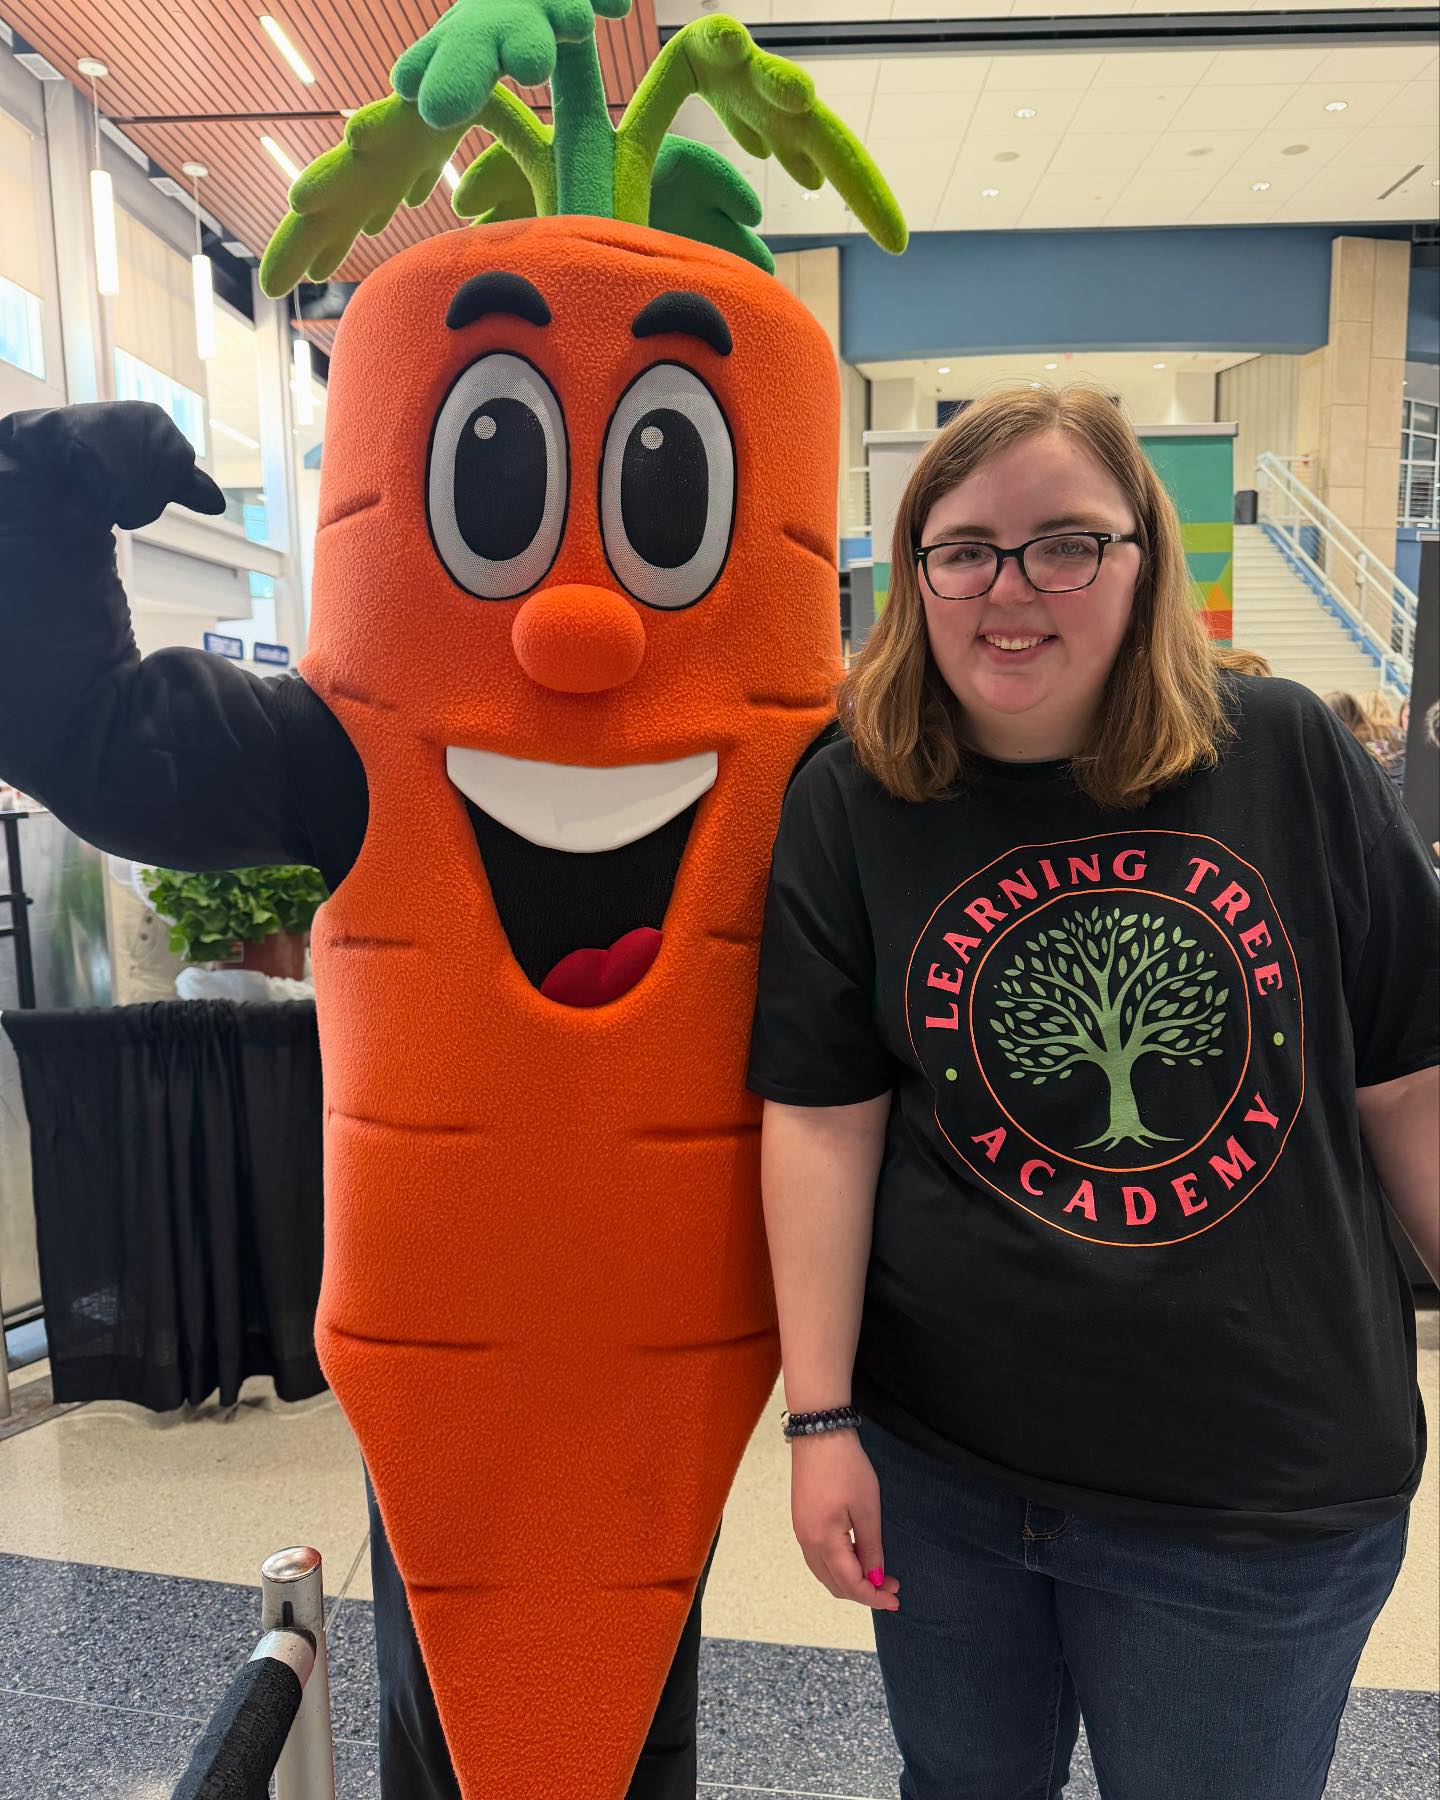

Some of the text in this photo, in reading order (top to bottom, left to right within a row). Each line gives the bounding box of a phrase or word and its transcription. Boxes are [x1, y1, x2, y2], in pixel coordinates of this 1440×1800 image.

[925, 849, 1283, 1030] LEARNING TREE
[971, 1092, 1279, 1226] ACADEMY
